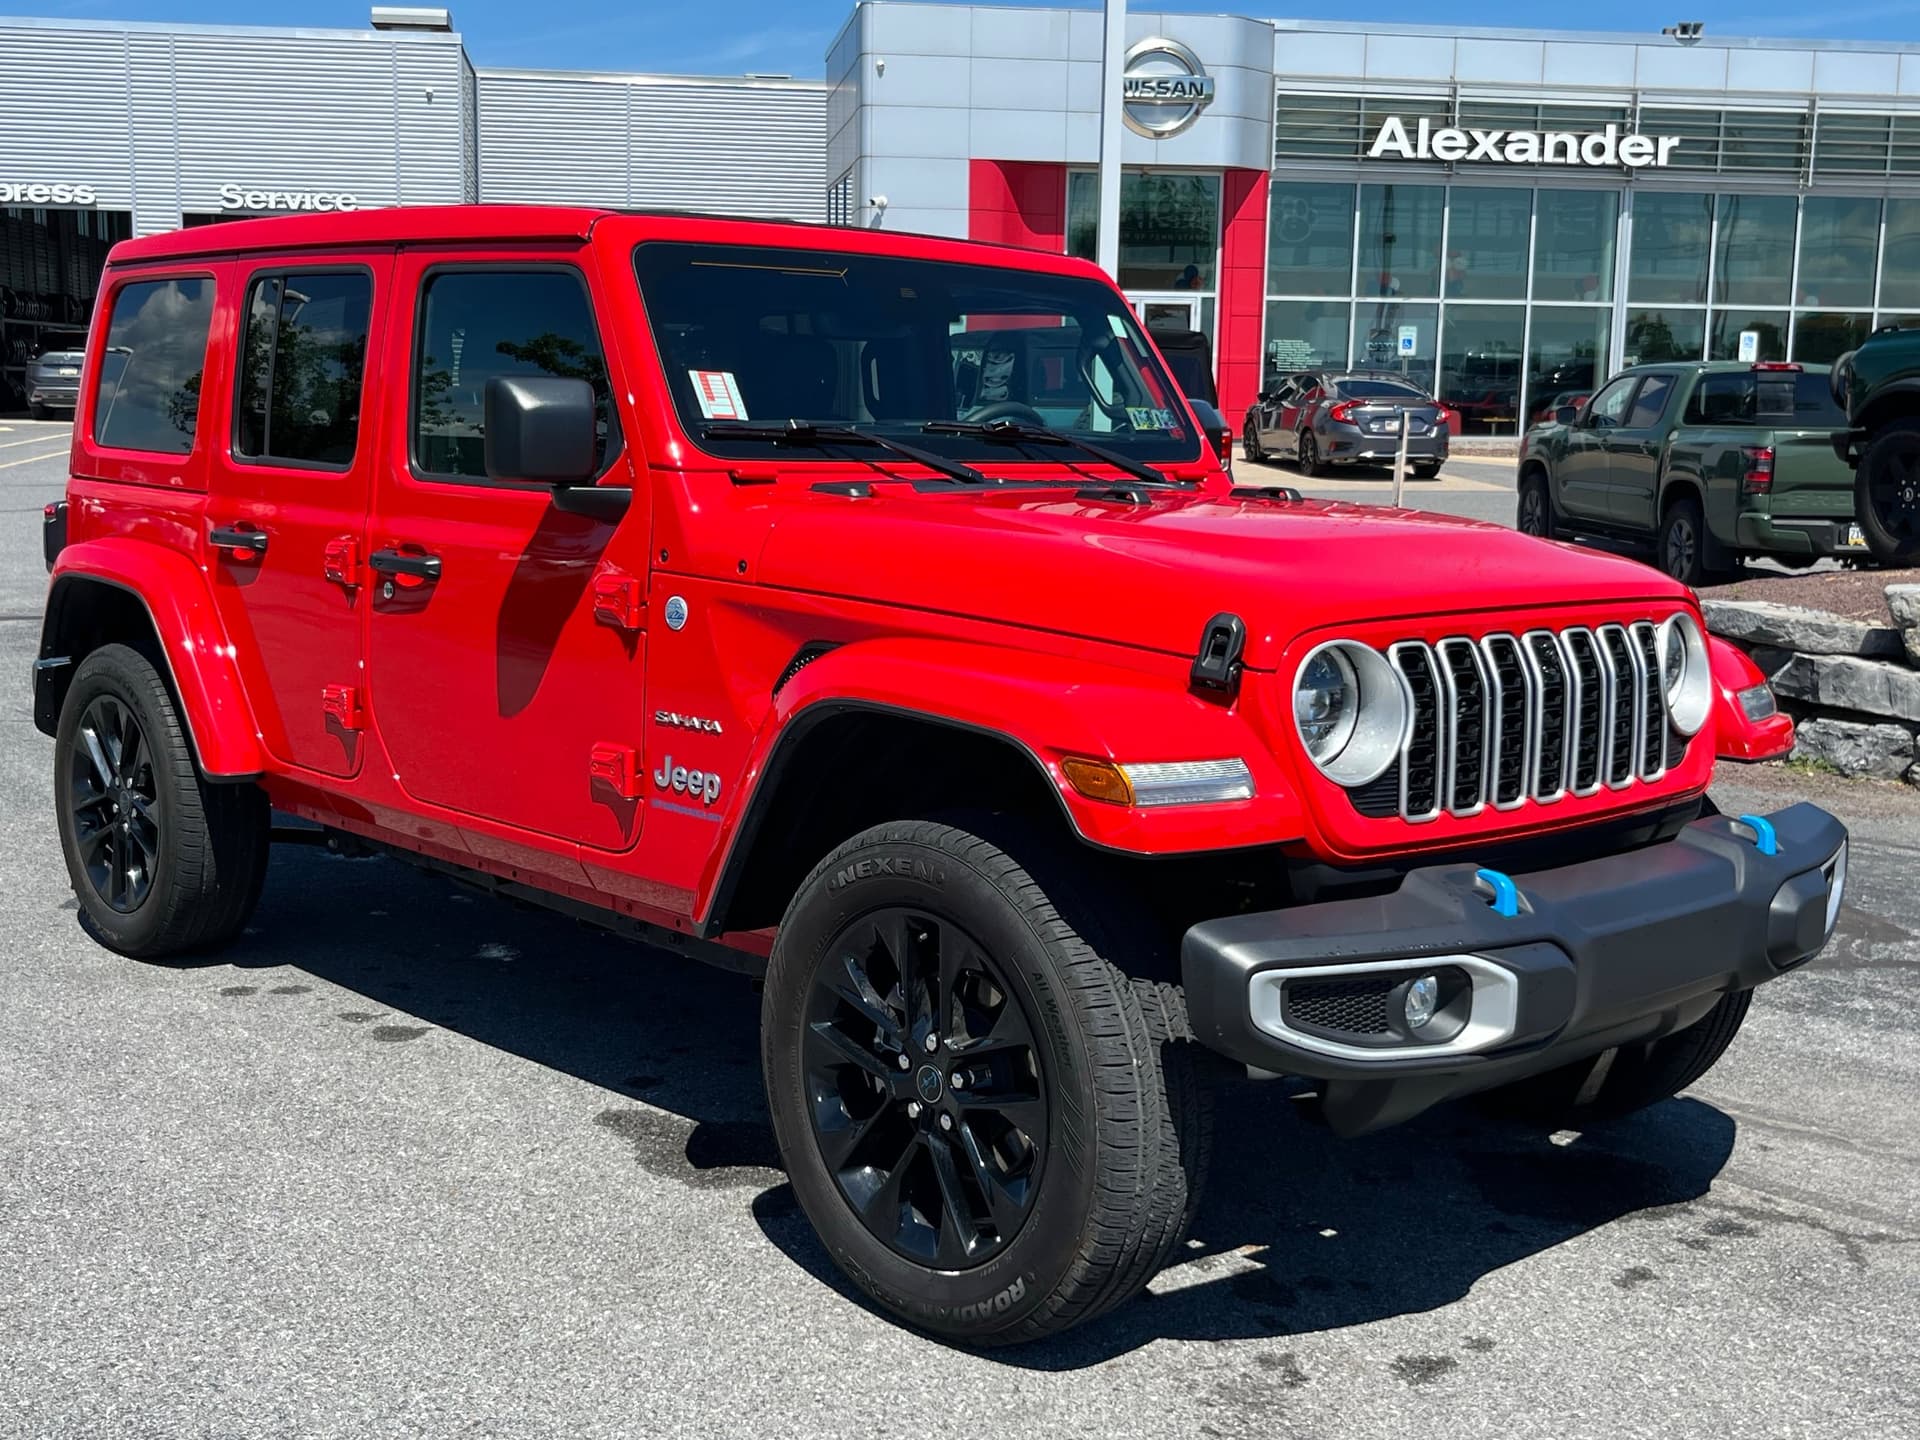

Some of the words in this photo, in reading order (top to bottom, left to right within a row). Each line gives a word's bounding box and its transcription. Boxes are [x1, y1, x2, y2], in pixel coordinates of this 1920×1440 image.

[1123, 80, 1204, 97] NISSAN
[1368, 117, 1680, 167] Alexander
[219, 183, 357, 212] Service
[655, 710, 723, 733] SAHARA
[653, 755, 721, 804] Jeep
[836, 858, 934, 888] NEXEN
